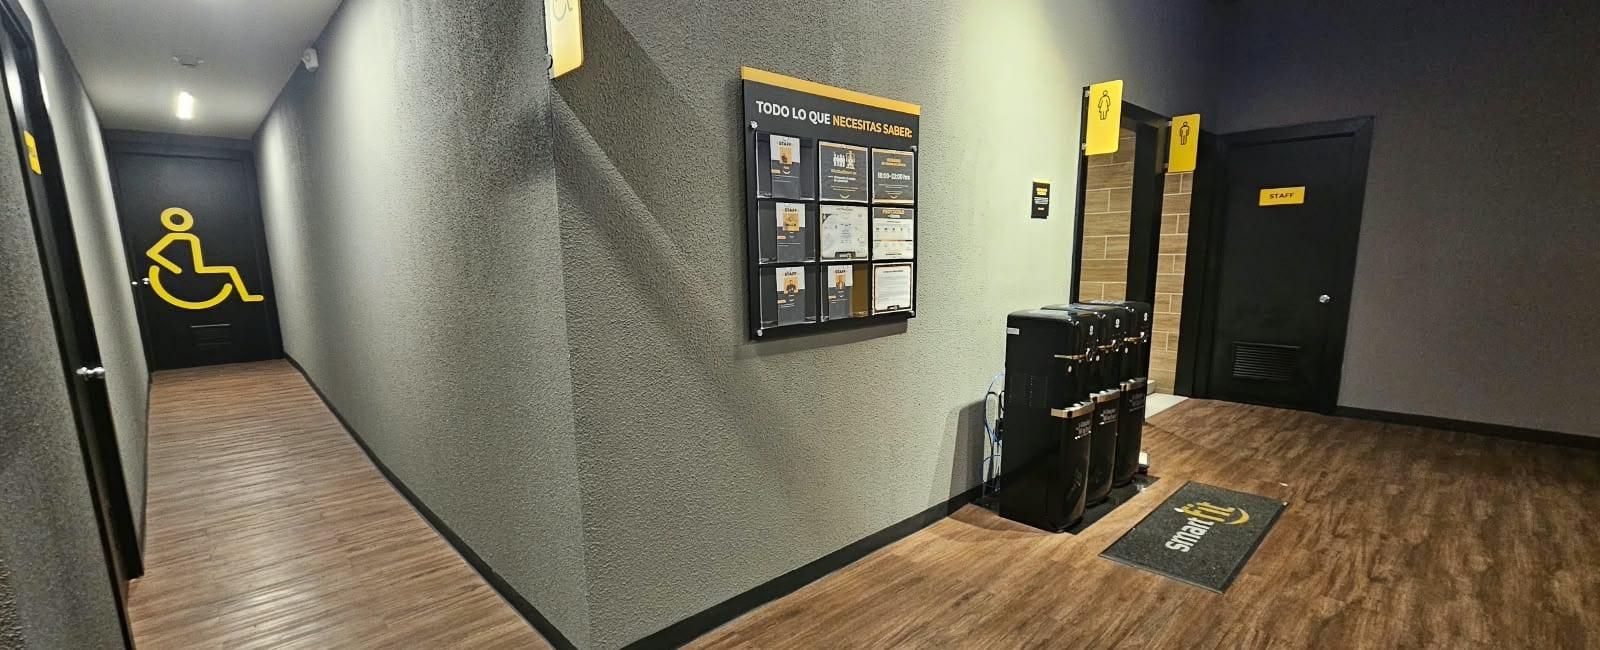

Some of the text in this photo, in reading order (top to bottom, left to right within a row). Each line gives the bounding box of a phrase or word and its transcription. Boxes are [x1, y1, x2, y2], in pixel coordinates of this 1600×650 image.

[756, 100, 913, 138] TODO LO QUE NECESITAS SABER:
[1164, 501, 1237, 553] smart fit
